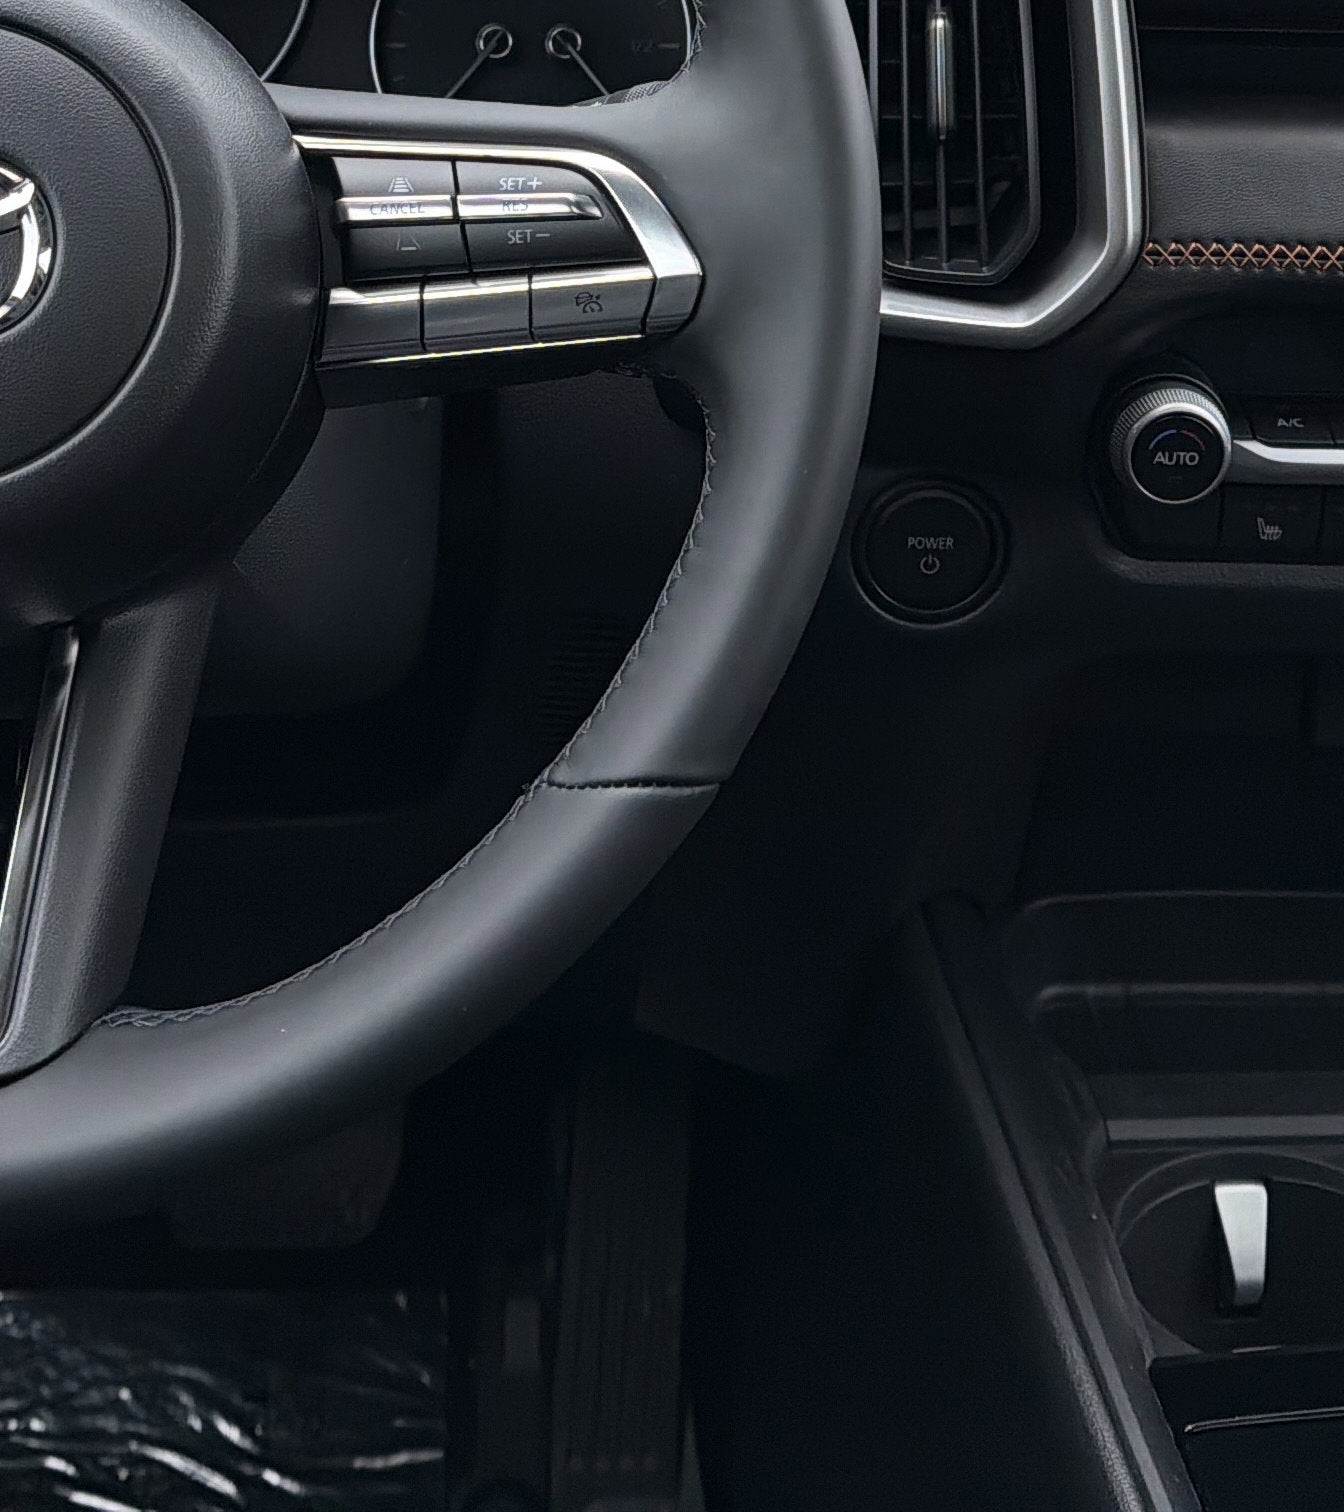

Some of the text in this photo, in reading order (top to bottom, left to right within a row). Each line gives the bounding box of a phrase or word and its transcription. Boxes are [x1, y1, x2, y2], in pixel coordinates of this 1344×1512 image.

[369, 200, 426, 216] CANCEL
[501, 197, 529, 213] RES
[1276, 416, 1305, 428] A/C
[1152, 449, 1200, 467] AUTO
[907, 536, 955, 550] POWER
